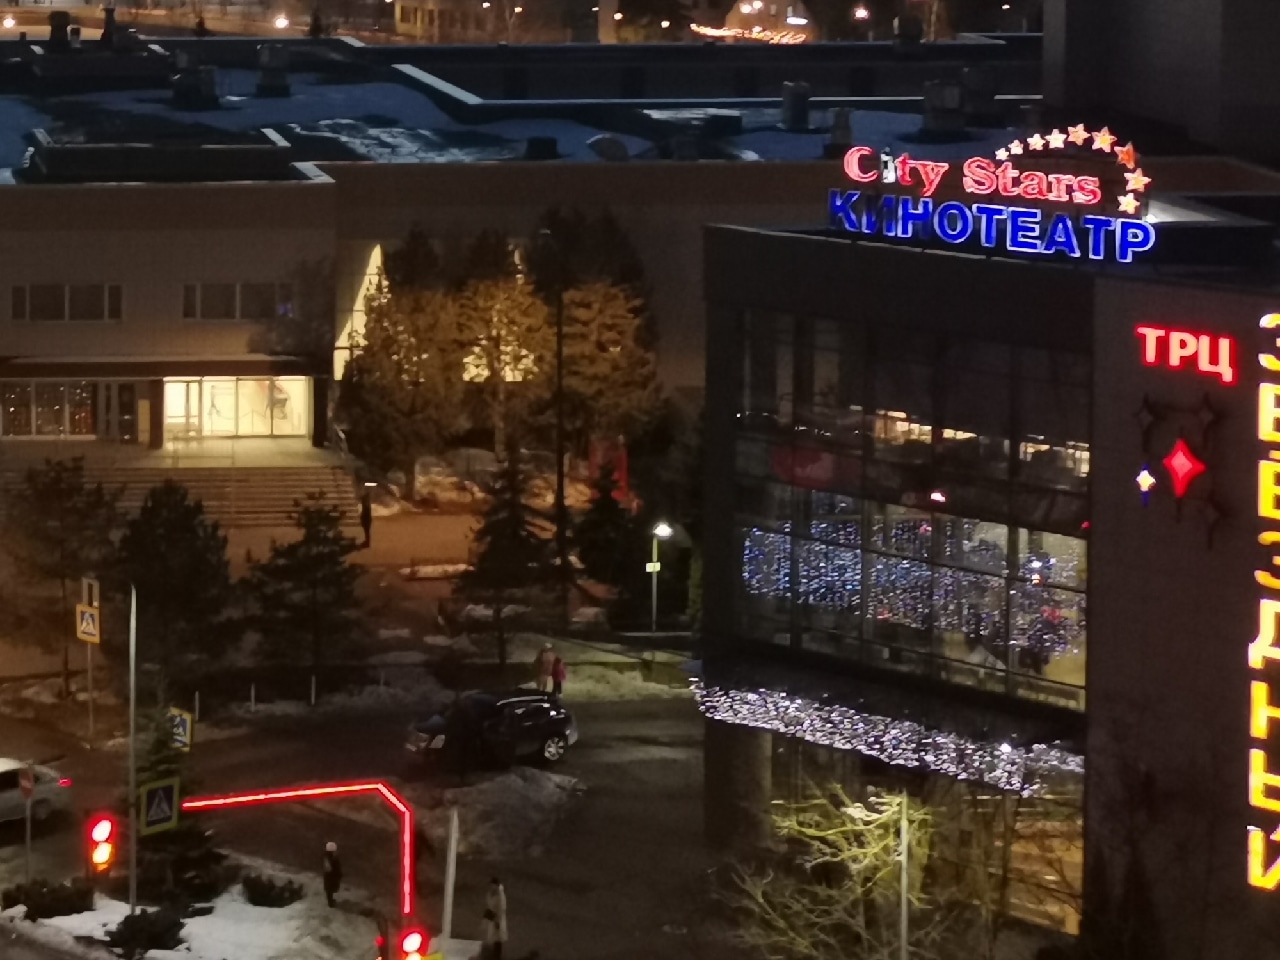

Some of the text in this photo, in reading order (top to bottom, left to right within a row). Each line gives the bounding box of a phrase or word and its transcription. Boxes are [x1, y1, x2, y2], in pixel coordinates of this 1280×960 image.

[843, 145, 1102, 205] City Stars
[828, 188, 1156, 262] КИНОТЕАТР
[1135, 324, 1238, 384] ТРЦ
